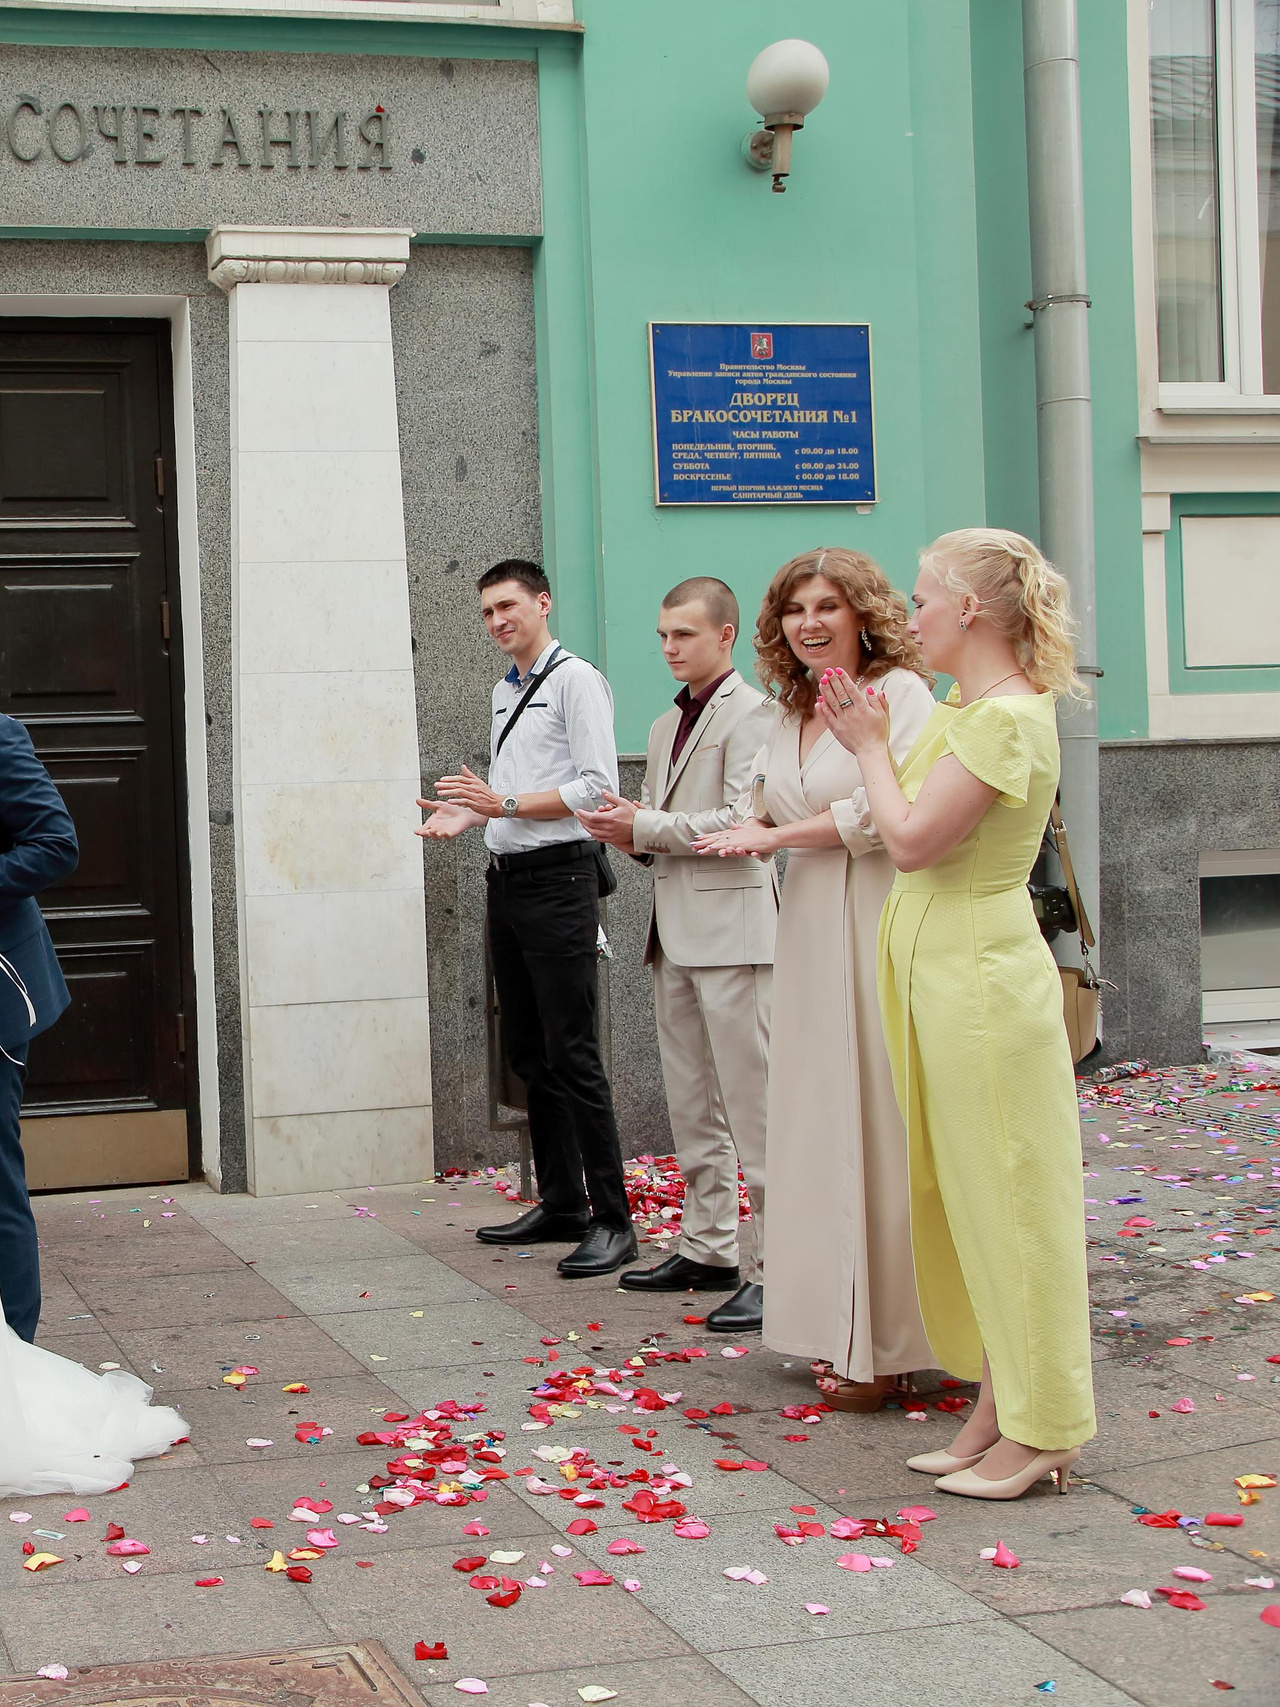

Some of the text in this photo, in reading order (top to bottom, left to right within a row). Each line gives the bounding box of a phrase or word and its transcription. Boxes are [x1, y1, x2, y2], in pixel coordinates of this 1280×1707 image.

[720, 363, 775, 371] Правительство
[667, 370, 713, 378] Управление
[729, 393, 800, 408] ДВОРЕЦ
[670, 410, 857, 423] БРАКОСОЧЕТАНИЯ №1
[732, 431, 799, 439] ЧАСЫ РАБОТЫ
